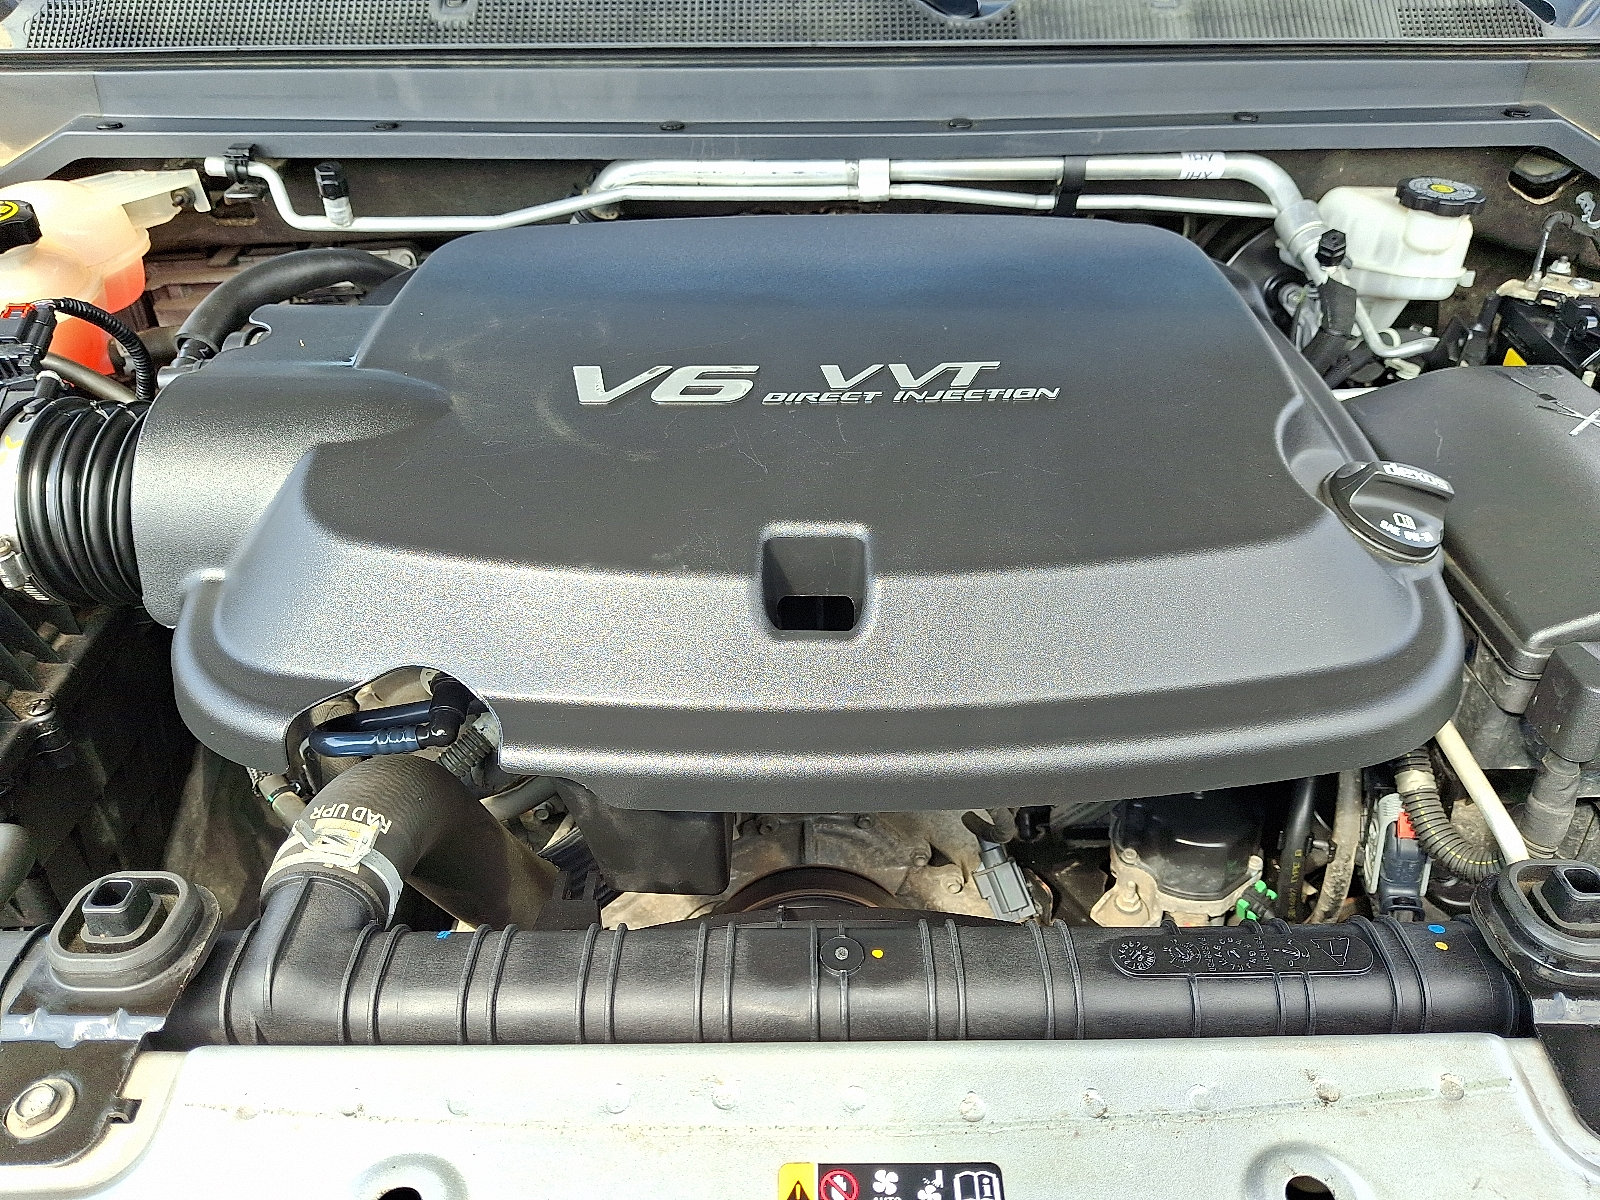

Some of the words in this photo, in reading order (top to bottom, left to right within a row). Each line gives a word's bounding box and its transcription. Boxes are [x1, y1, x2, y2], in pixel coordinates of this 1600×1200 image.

[573, 364, 760, 404] V6
[818, 360, 1001, 390] VVT
[762, 391, 884, 404] DIRECT
[892, 386, 1061, 404] INJECTION
[309, 803, 350, 820] UPR
[351, 806, 393, 835] RAD
